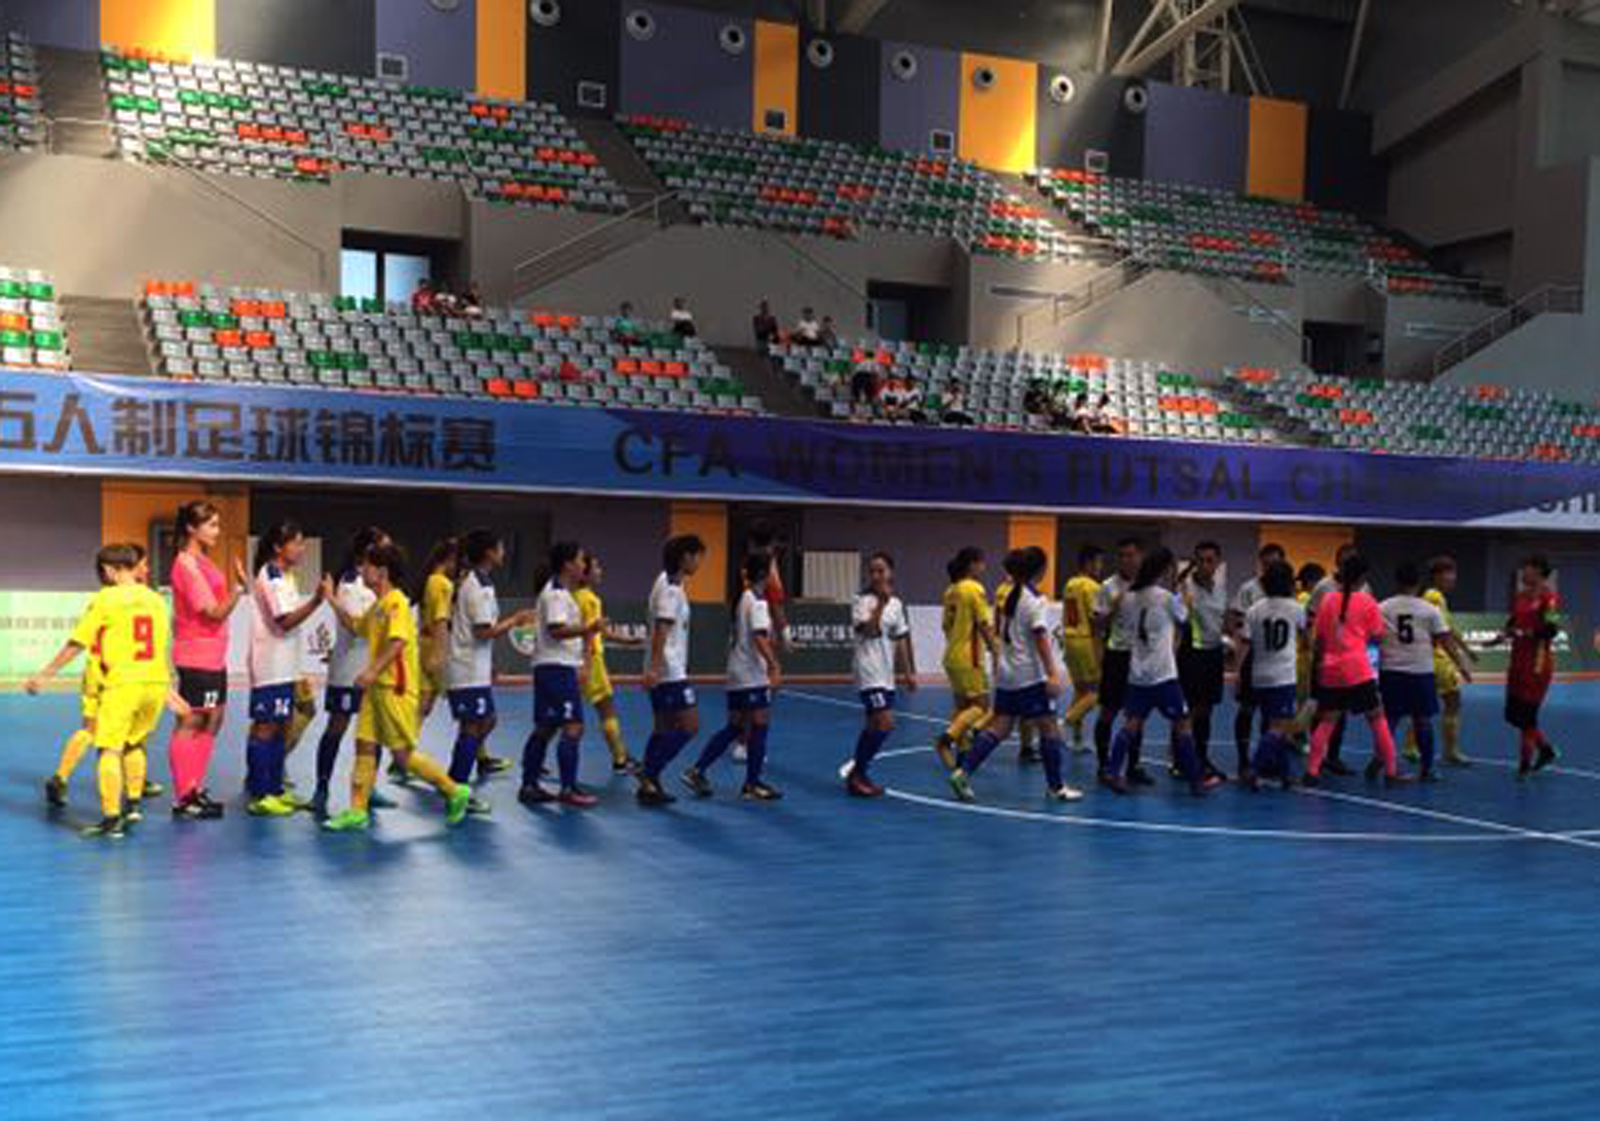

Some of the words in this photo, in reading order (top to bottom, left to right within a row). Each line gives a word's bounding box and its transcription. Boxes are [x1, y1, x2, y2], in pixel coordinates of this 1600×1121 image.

[613, 428, 739, 479] CFA
[133, 615, 154, 661] 9
[1262, 618, 1290, 652] 10
[1397, 613, 1415, 644] 5
